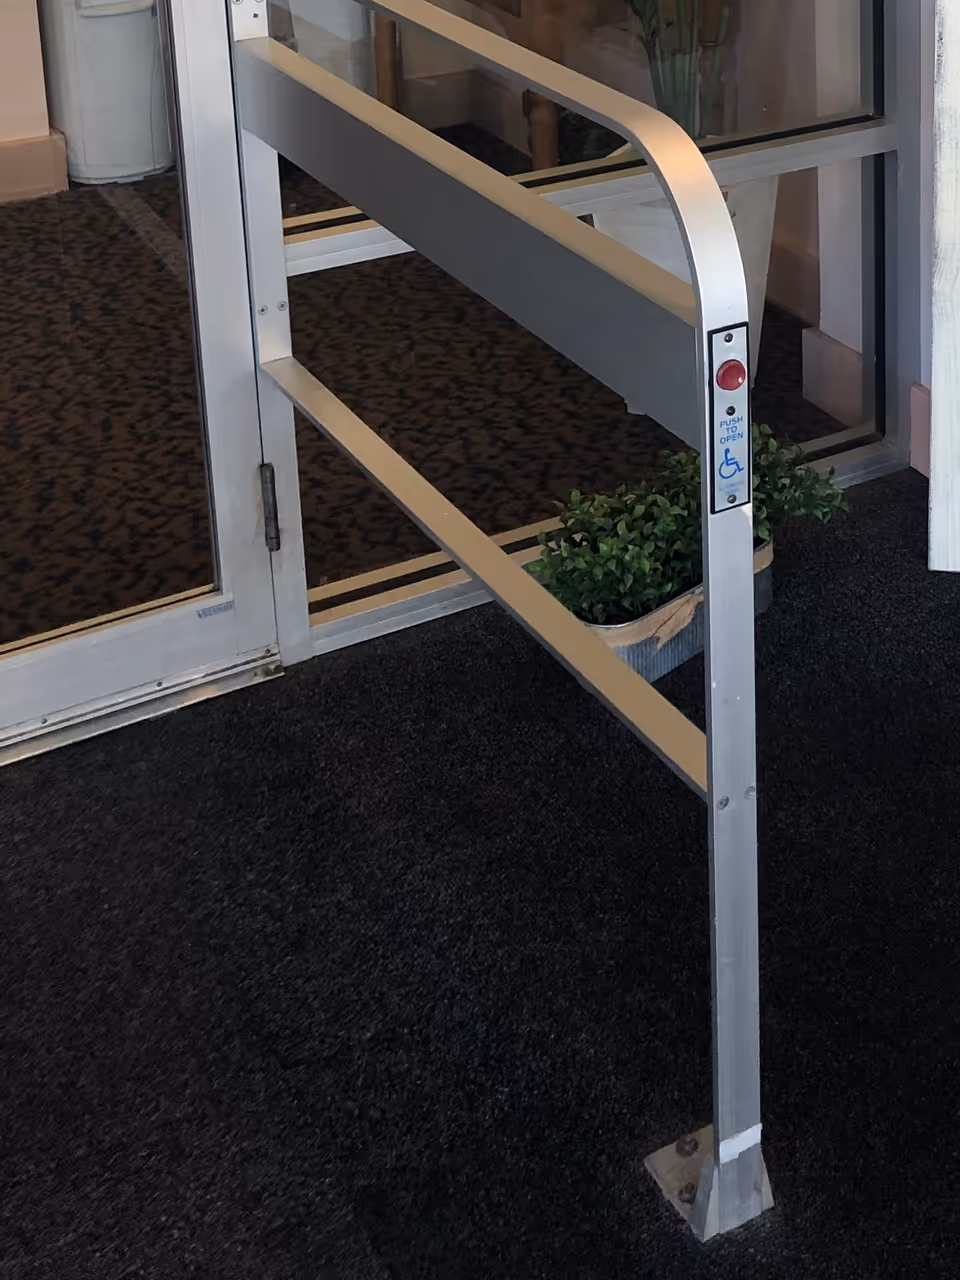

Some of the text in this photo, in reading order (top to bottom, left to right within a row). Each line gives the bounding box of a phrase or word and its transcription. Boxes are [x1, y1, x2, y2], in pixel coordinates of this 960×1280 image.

[720, 416, 743, 428] PUSH
[726, 426, 738, 434] TO
[720, 432, 744, 444] OPEN
